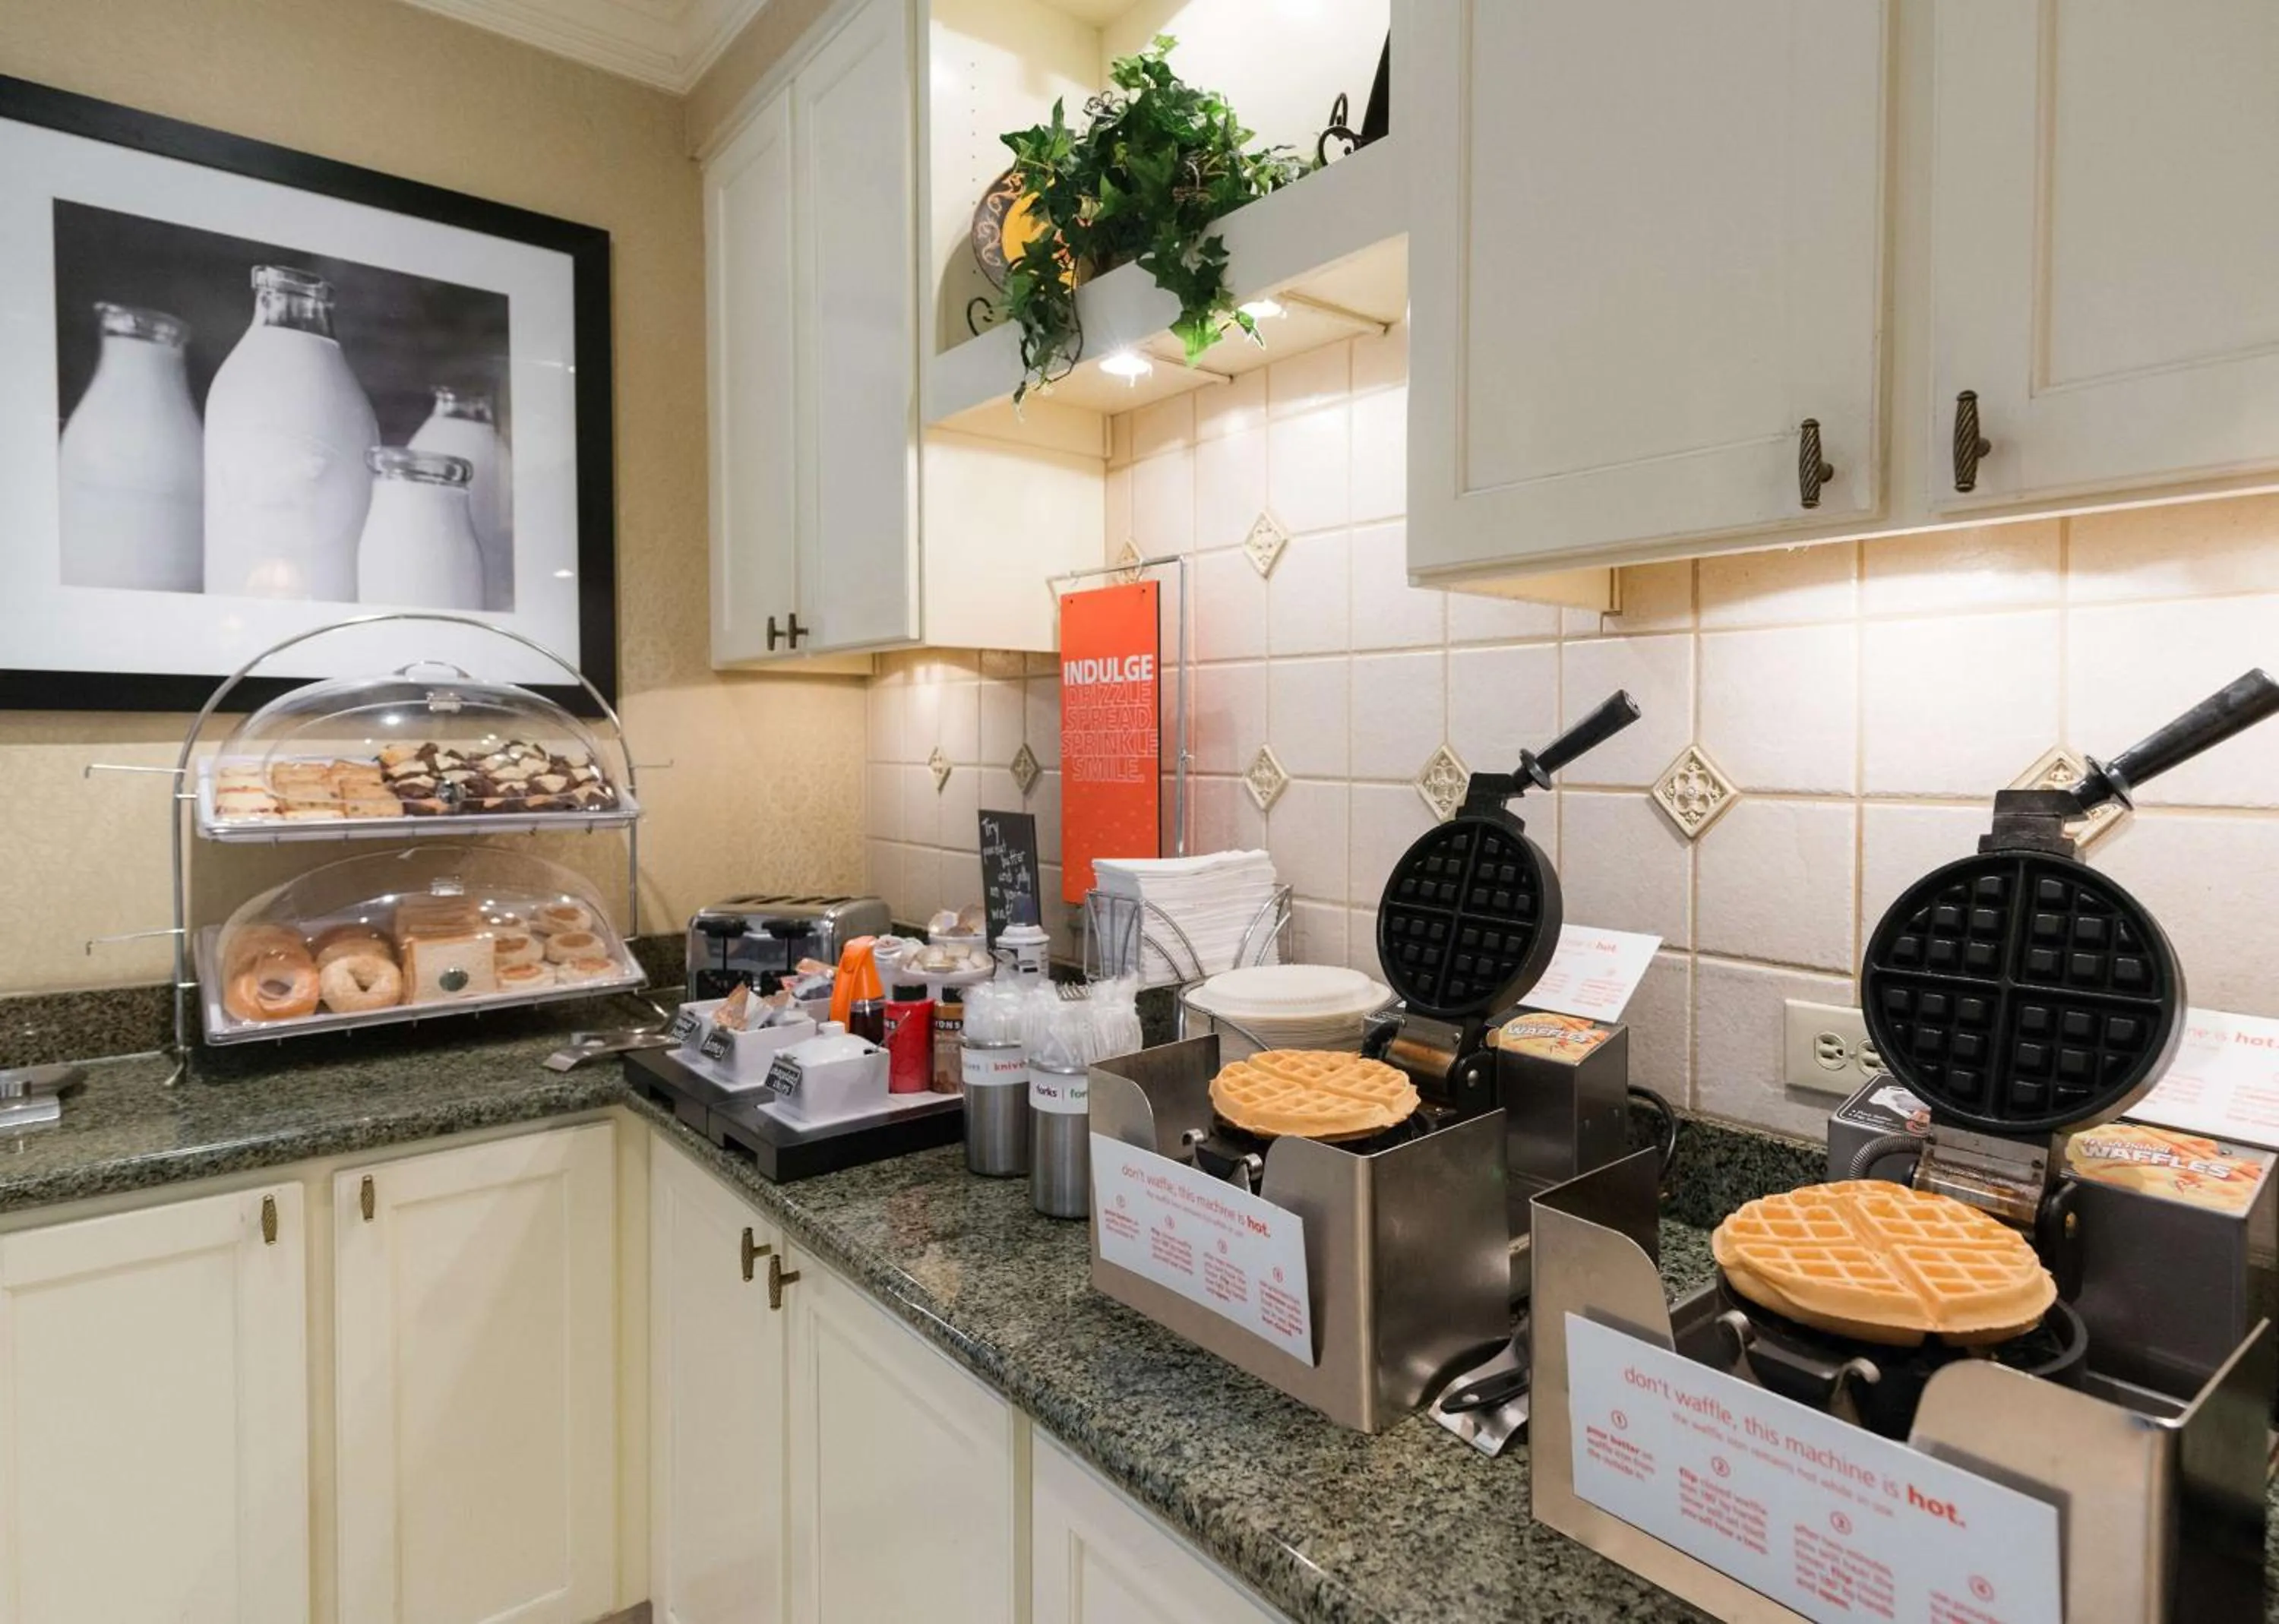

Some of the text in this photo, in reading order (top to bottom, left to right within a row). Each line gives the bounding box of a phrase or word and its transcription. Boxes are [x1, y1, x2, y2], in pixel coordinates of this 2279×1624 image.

[1064, 654, 1153, 685] INDULGE
[1067, 681, 1152, 708] DRIZZLE
[1066, 706, 1152, 731] SPREAD
[1061, 729, 1157, 757] SPRINKLE
[981, 817, 999, 845] Try
[1070, 1088, 1087, 1099] for
[2081, 1143, 2233, 1179] WAFFLES
[1623, 1365, 1967, 1529] don't waffle, this machine is hot.
